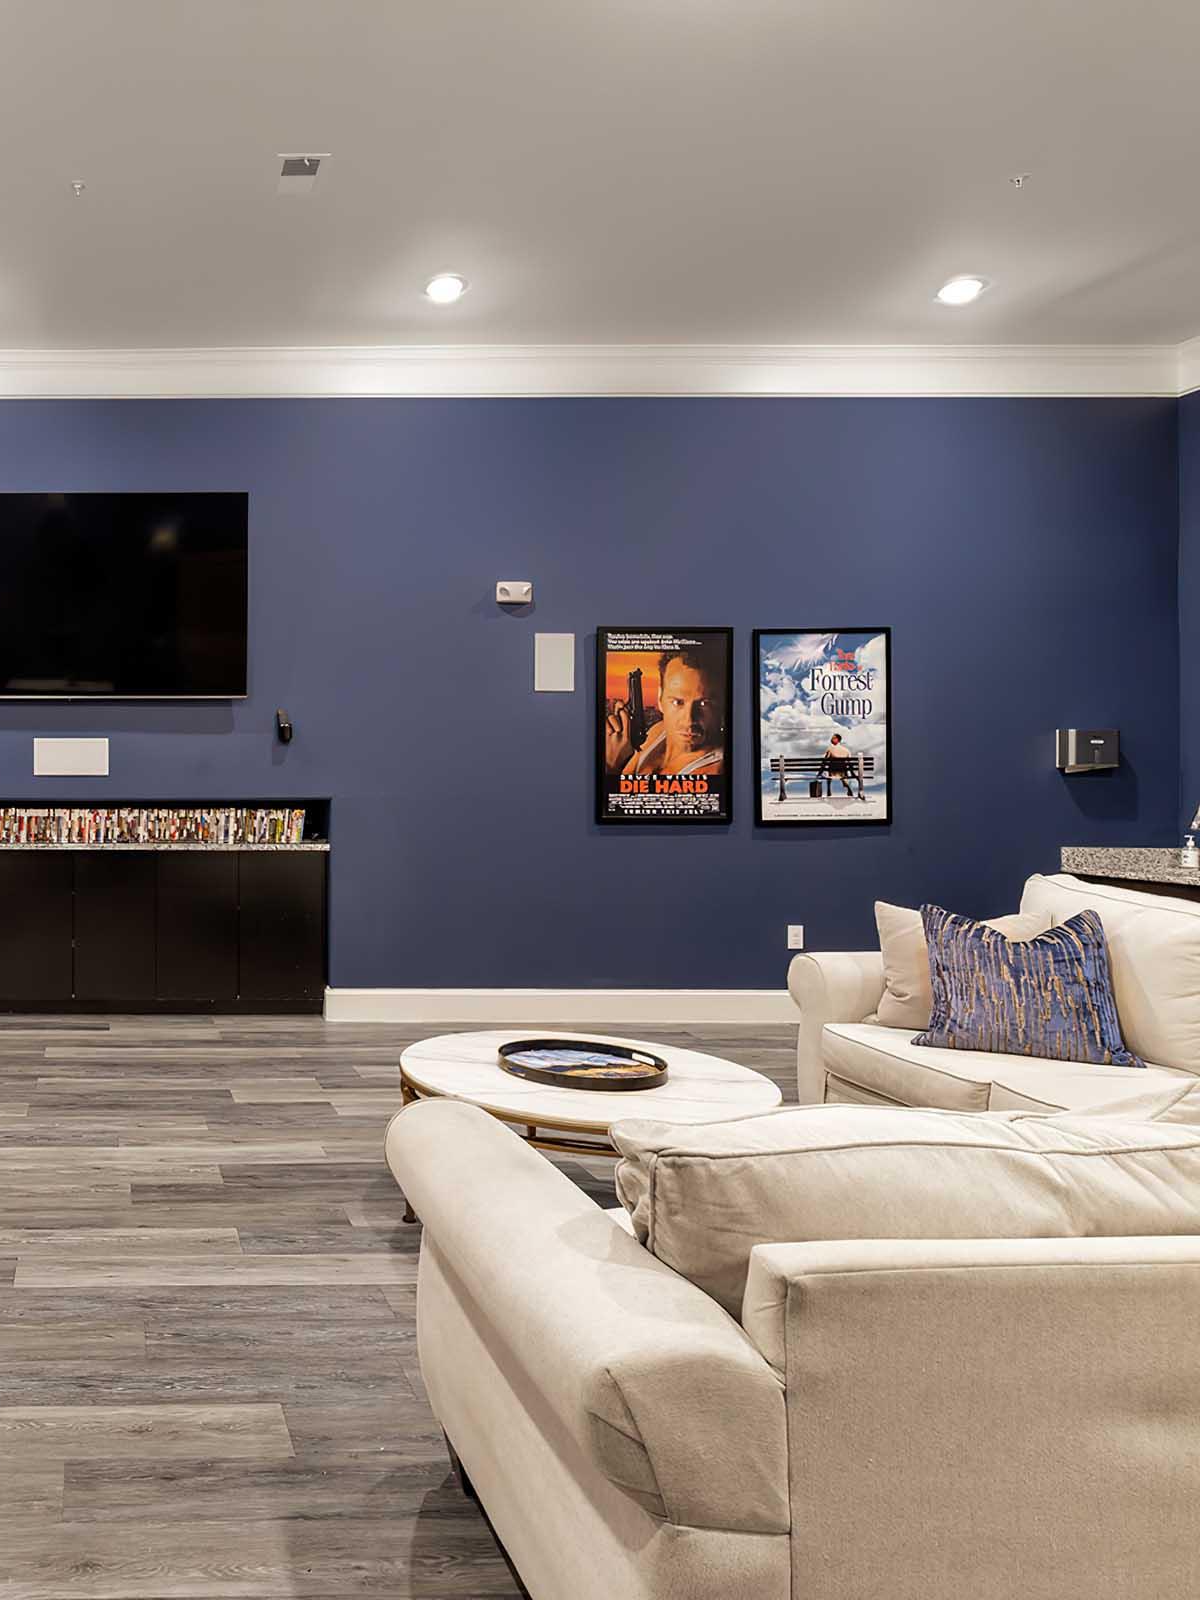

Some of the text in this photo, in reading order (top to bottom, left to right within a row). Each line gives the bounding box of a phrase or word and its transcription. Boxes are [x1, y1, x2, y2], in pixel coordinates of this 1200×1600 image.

[810, 668, 874, 692] Forrest
[821, 692, 873, 719] Gump
[619, 780, 709, 793] DIE HARD
